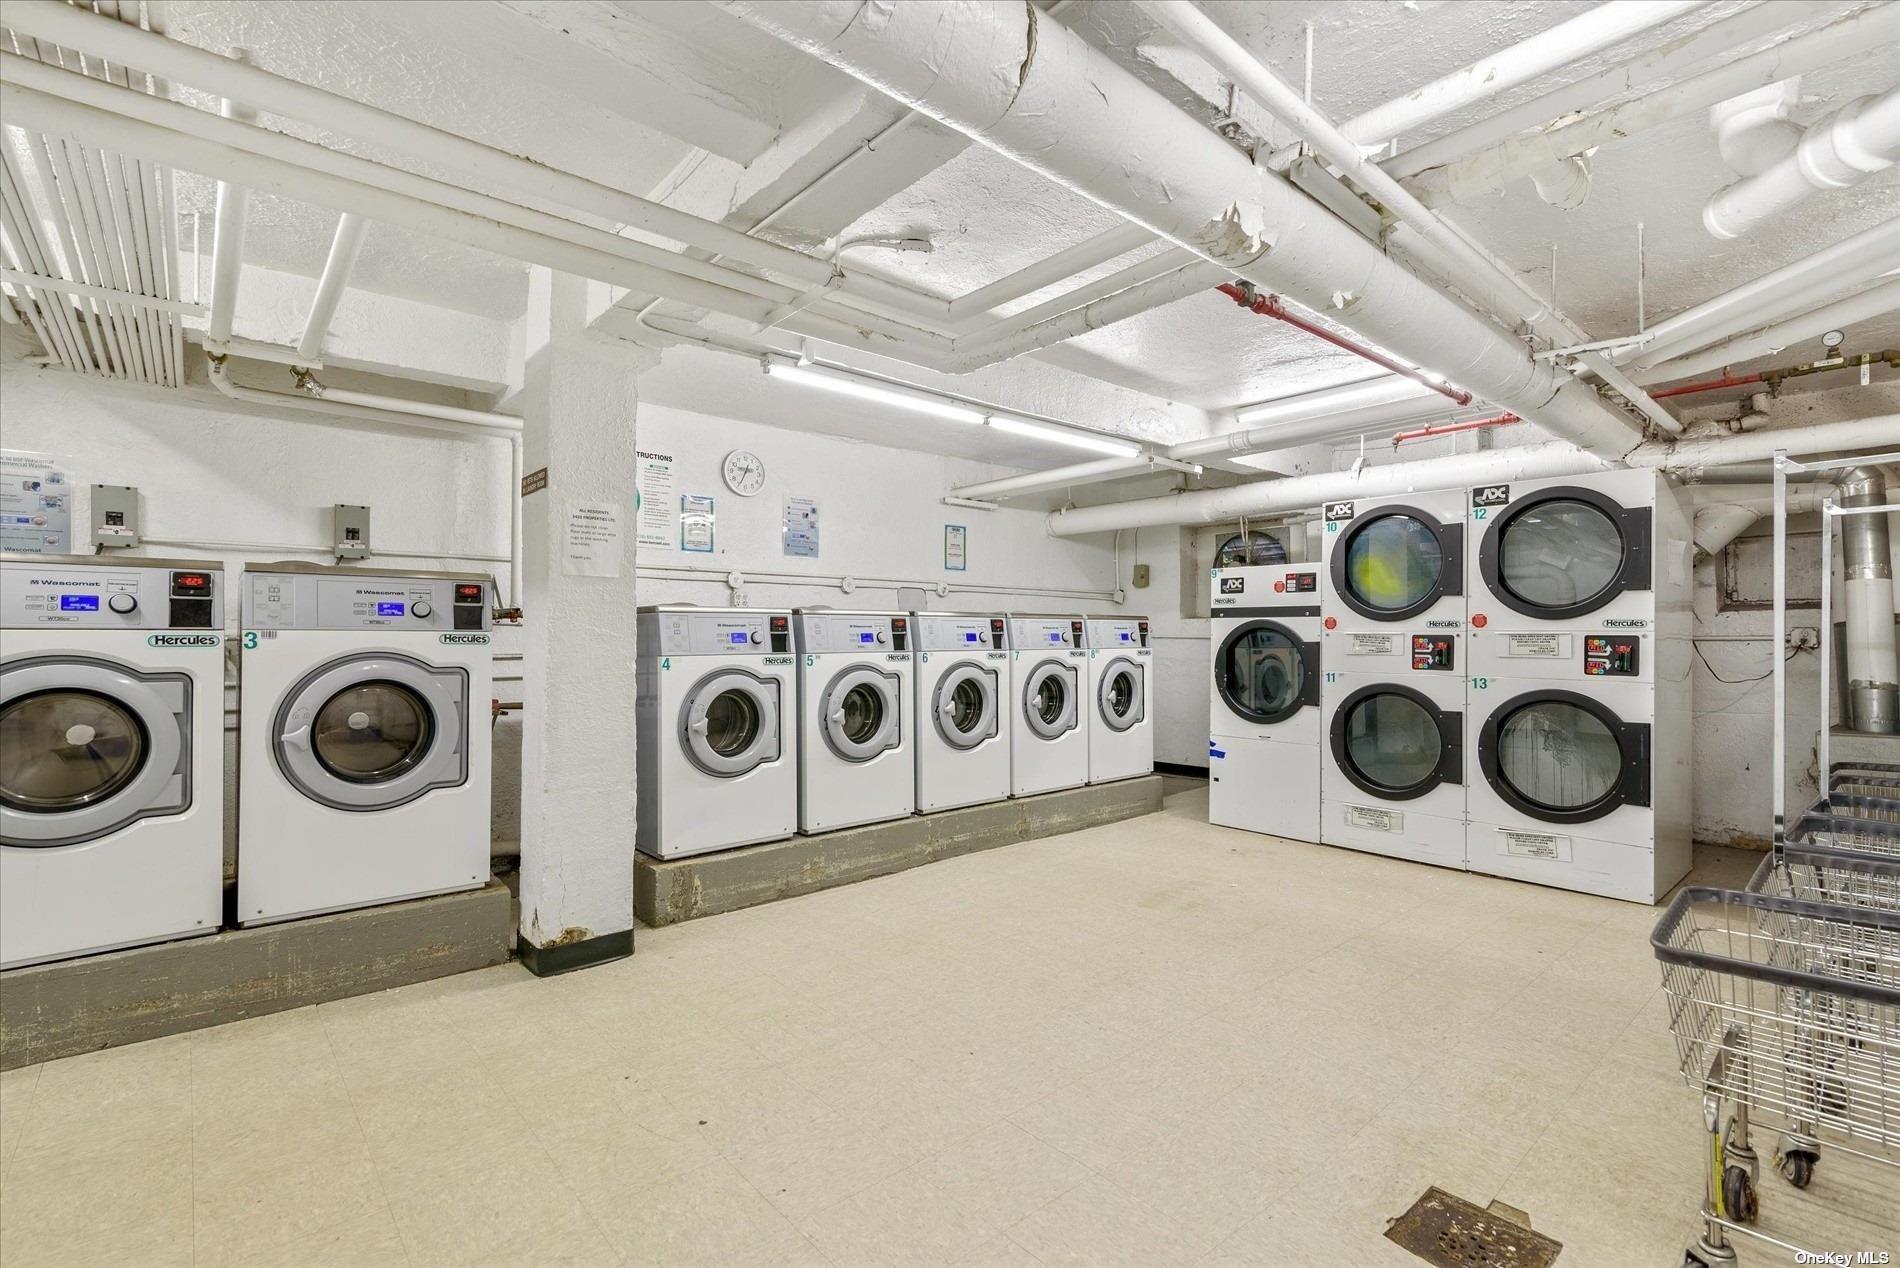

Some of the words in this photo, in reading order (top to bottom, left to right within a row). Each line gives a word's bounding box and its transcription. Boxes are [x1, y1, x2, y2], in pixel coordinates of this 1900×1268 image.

[637, 451, 672, 462] TRUCTIONS
[1473, 508, 1487, 519] 12
[1326, 522, 1337, 532] 10
[1211, 569, 1217, 578] 9
[154, 634, 216, 646] Hercules
[244, 632, 258, 649] 3
[444, 634, 486, 644] Hercules
[807, 654, 814, 666] 5
[922, 652, 928, 662] 6
[1015, 652, 1019, 660] 7
[1091, 651, 1095, 659] 8
[662, 657, 670, 671] 4
[1326, 673, 1336, 682] 11
[1472, 678, 1488, 689] 13
